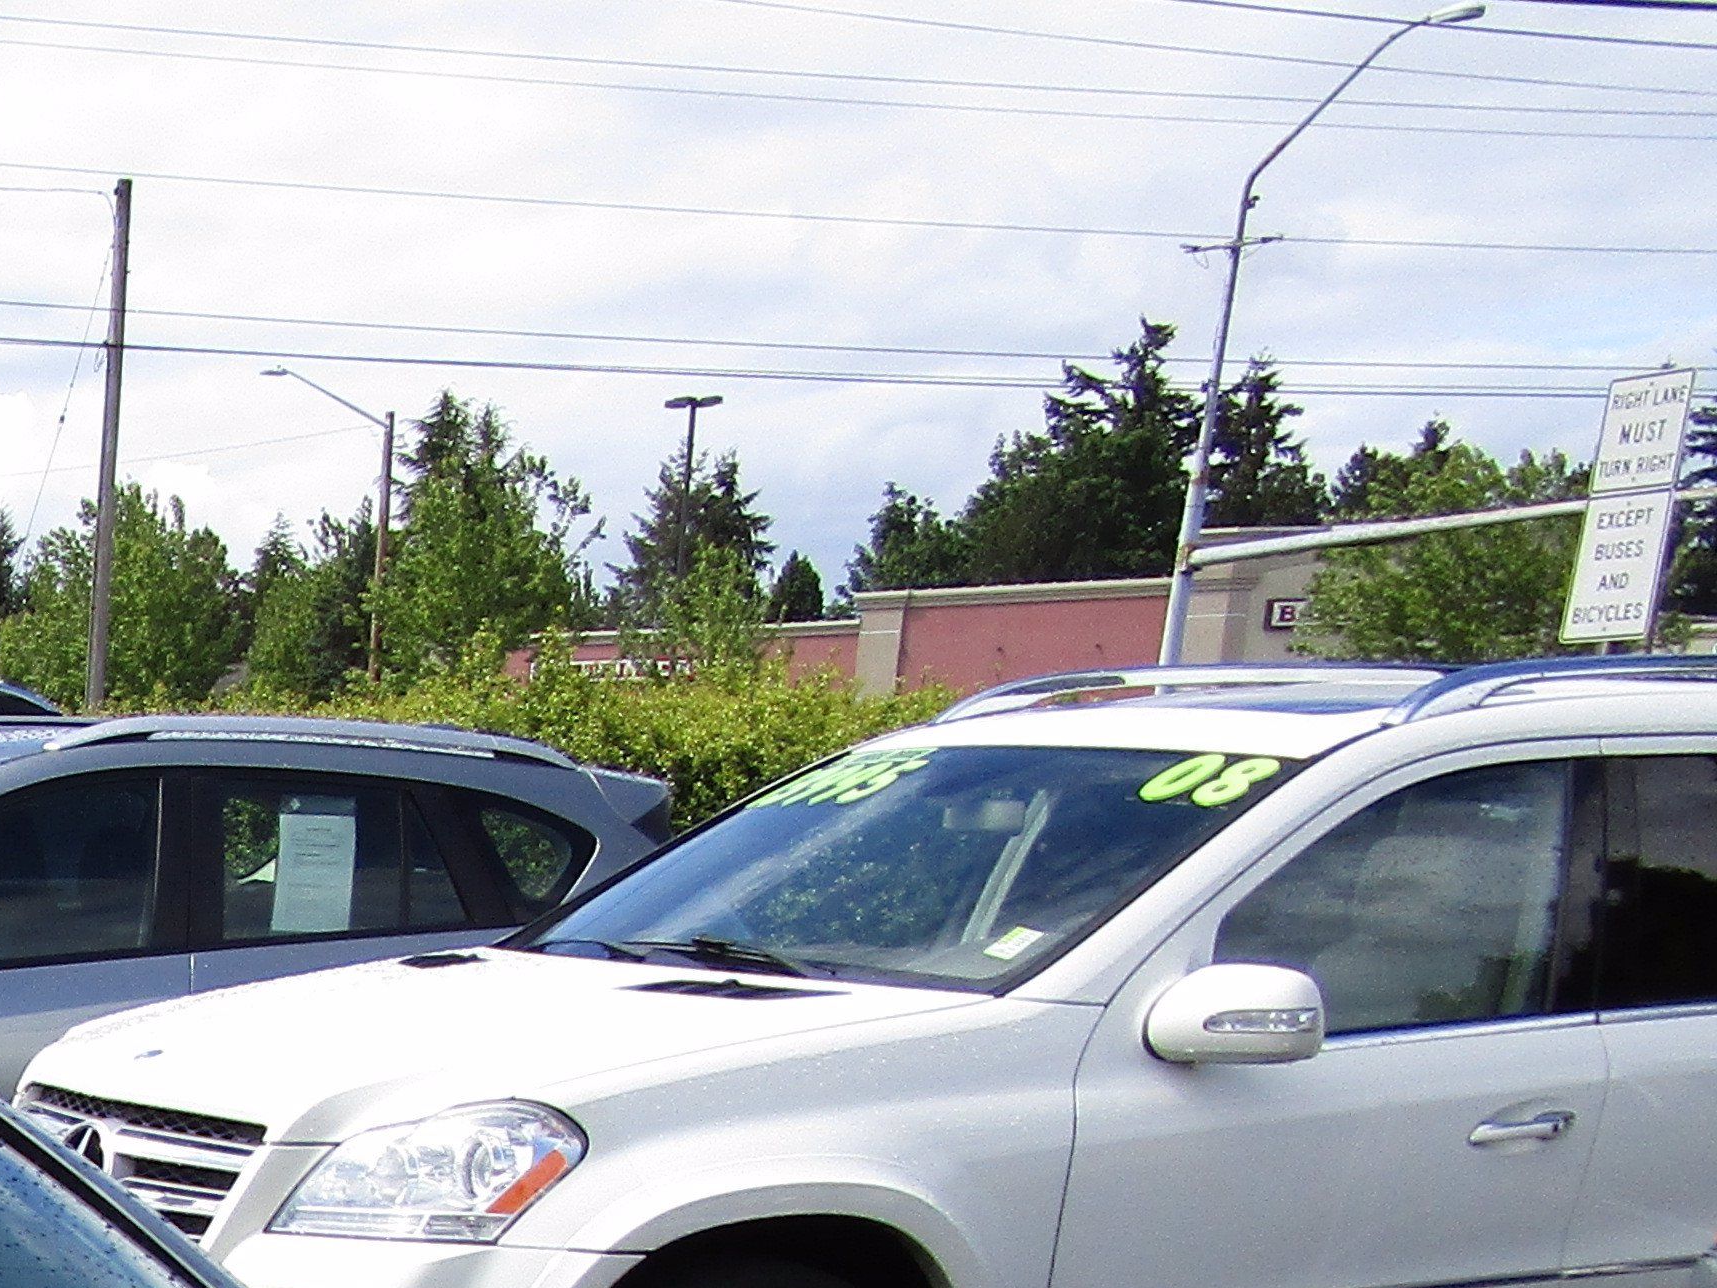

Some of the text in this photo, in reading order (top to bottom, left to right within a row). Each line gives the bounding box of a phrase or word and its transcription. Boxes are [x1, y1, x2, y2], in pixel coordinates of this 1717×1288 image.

[1612, 384, 1688, 410] RIGHT LANE
[1619, 418, 1668, 445] MUST
[1599, 453, 1675, 479] TURN RIGHT
[1596, 507, 1654, 530] EXCEPT
[1594, 539, 1645, 561] BUSES
[1596, 571, 1630, 591] AND
[1572, 602, 1644, 625] BICYCLES
[1137, 753, 1281, 808] 08
